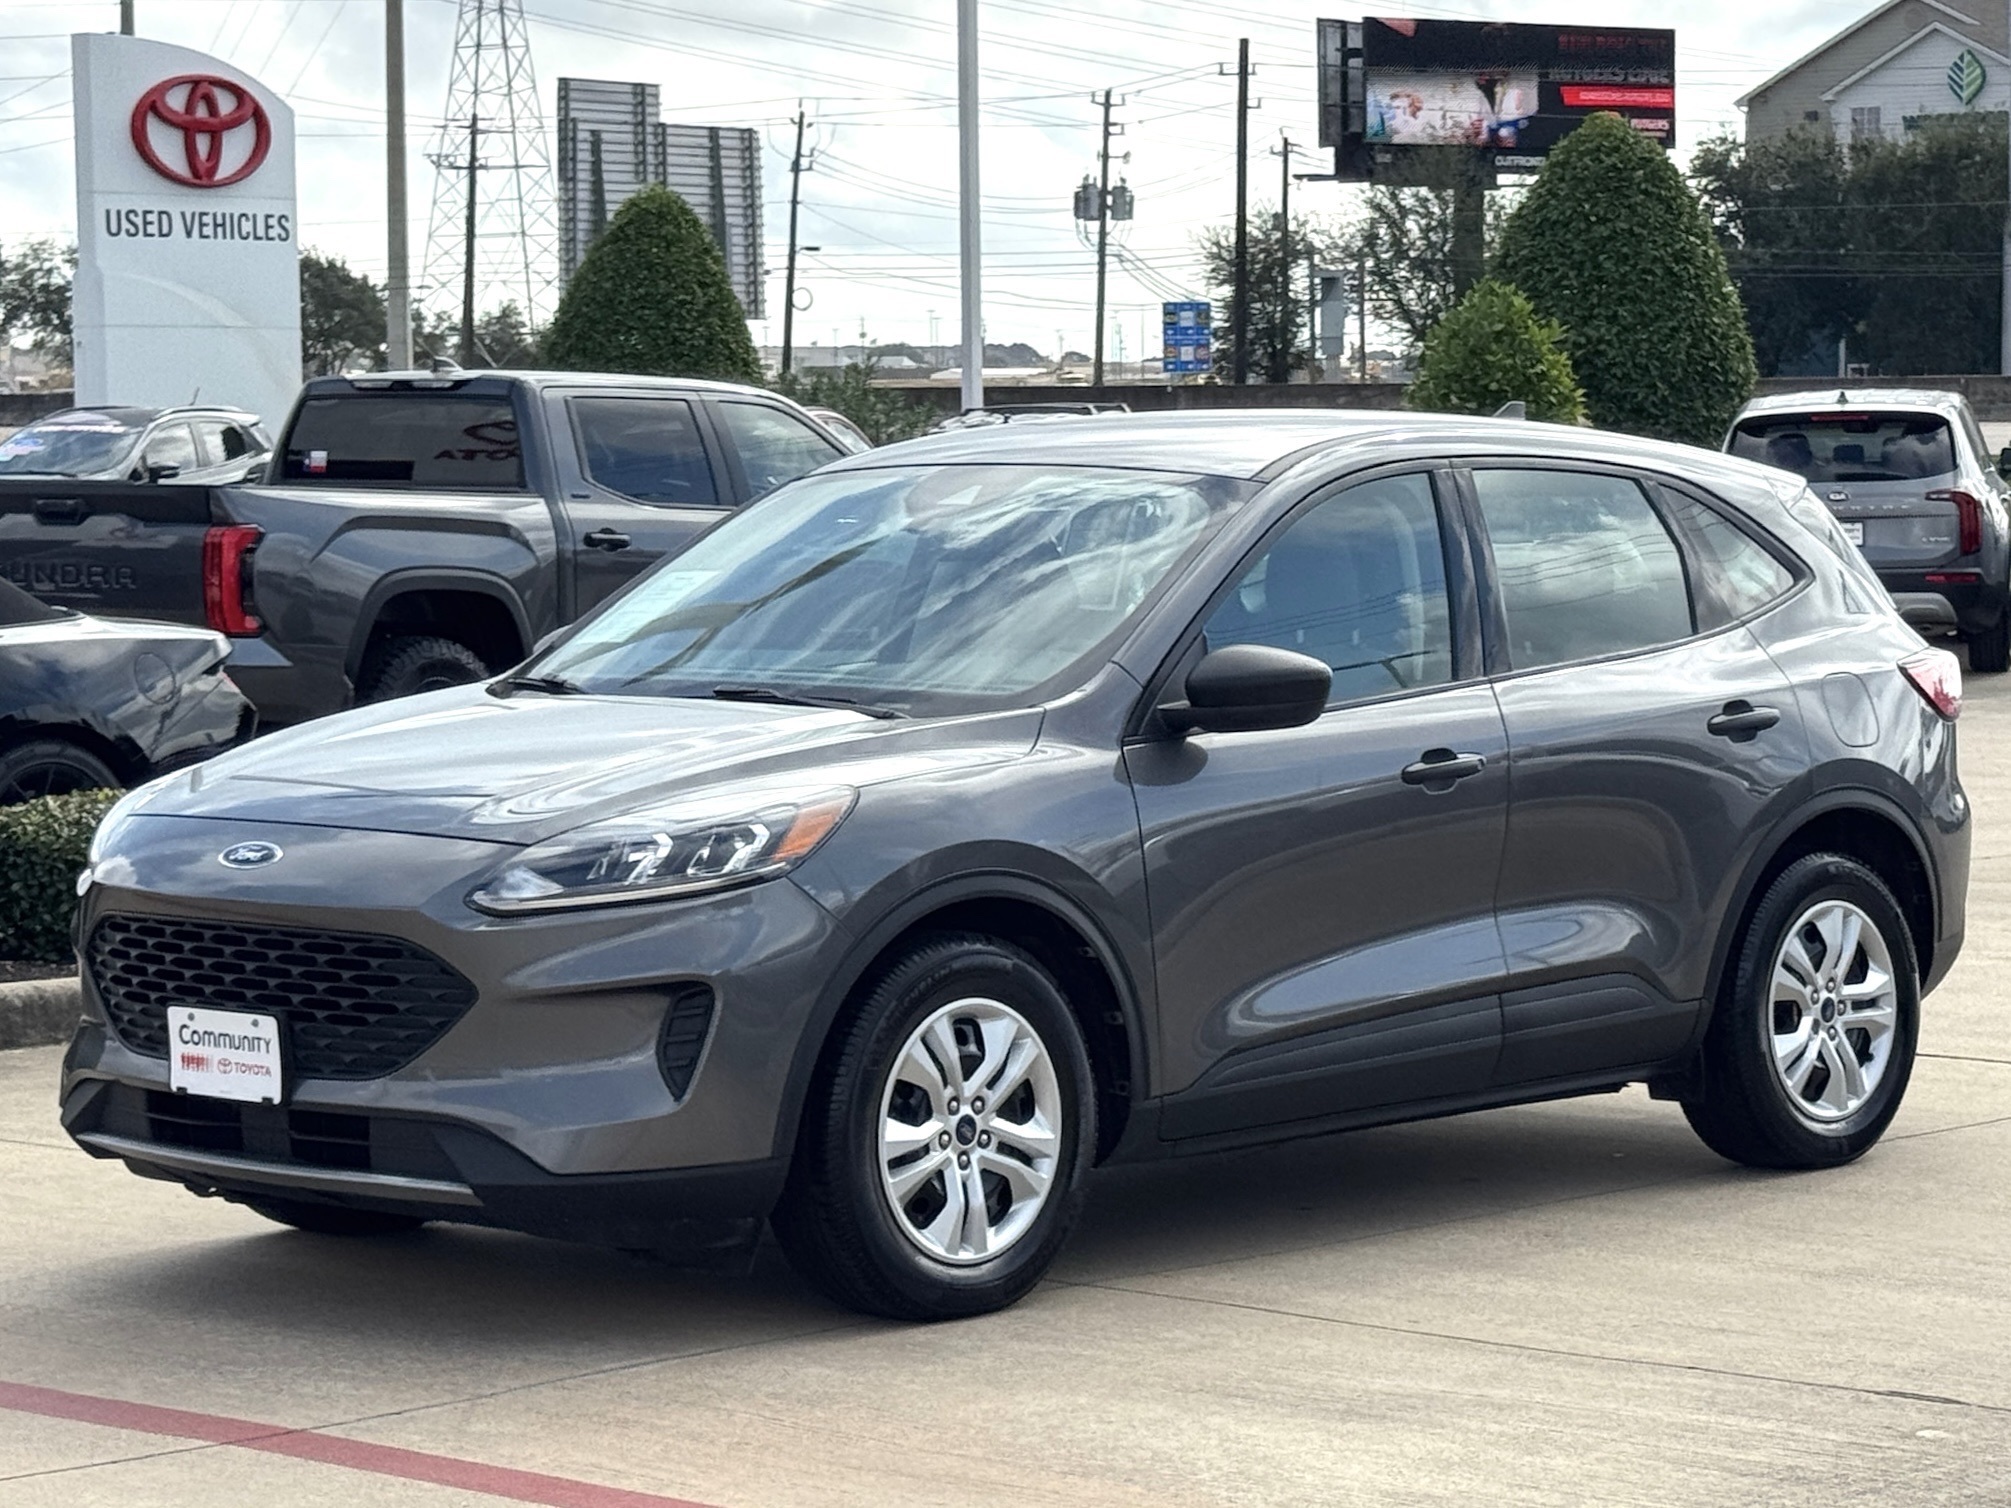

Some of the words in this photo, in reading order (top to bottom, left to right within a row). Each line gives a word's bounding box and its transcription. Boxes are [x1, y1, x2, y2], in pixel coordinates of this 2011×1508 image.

[105, 208, 173, 238] USED
[180, 211, 291, 242] VEHICLES
[1, 560, 137, 590] UNDRA
[234, 1061, 272, 1077] TOYOTA
